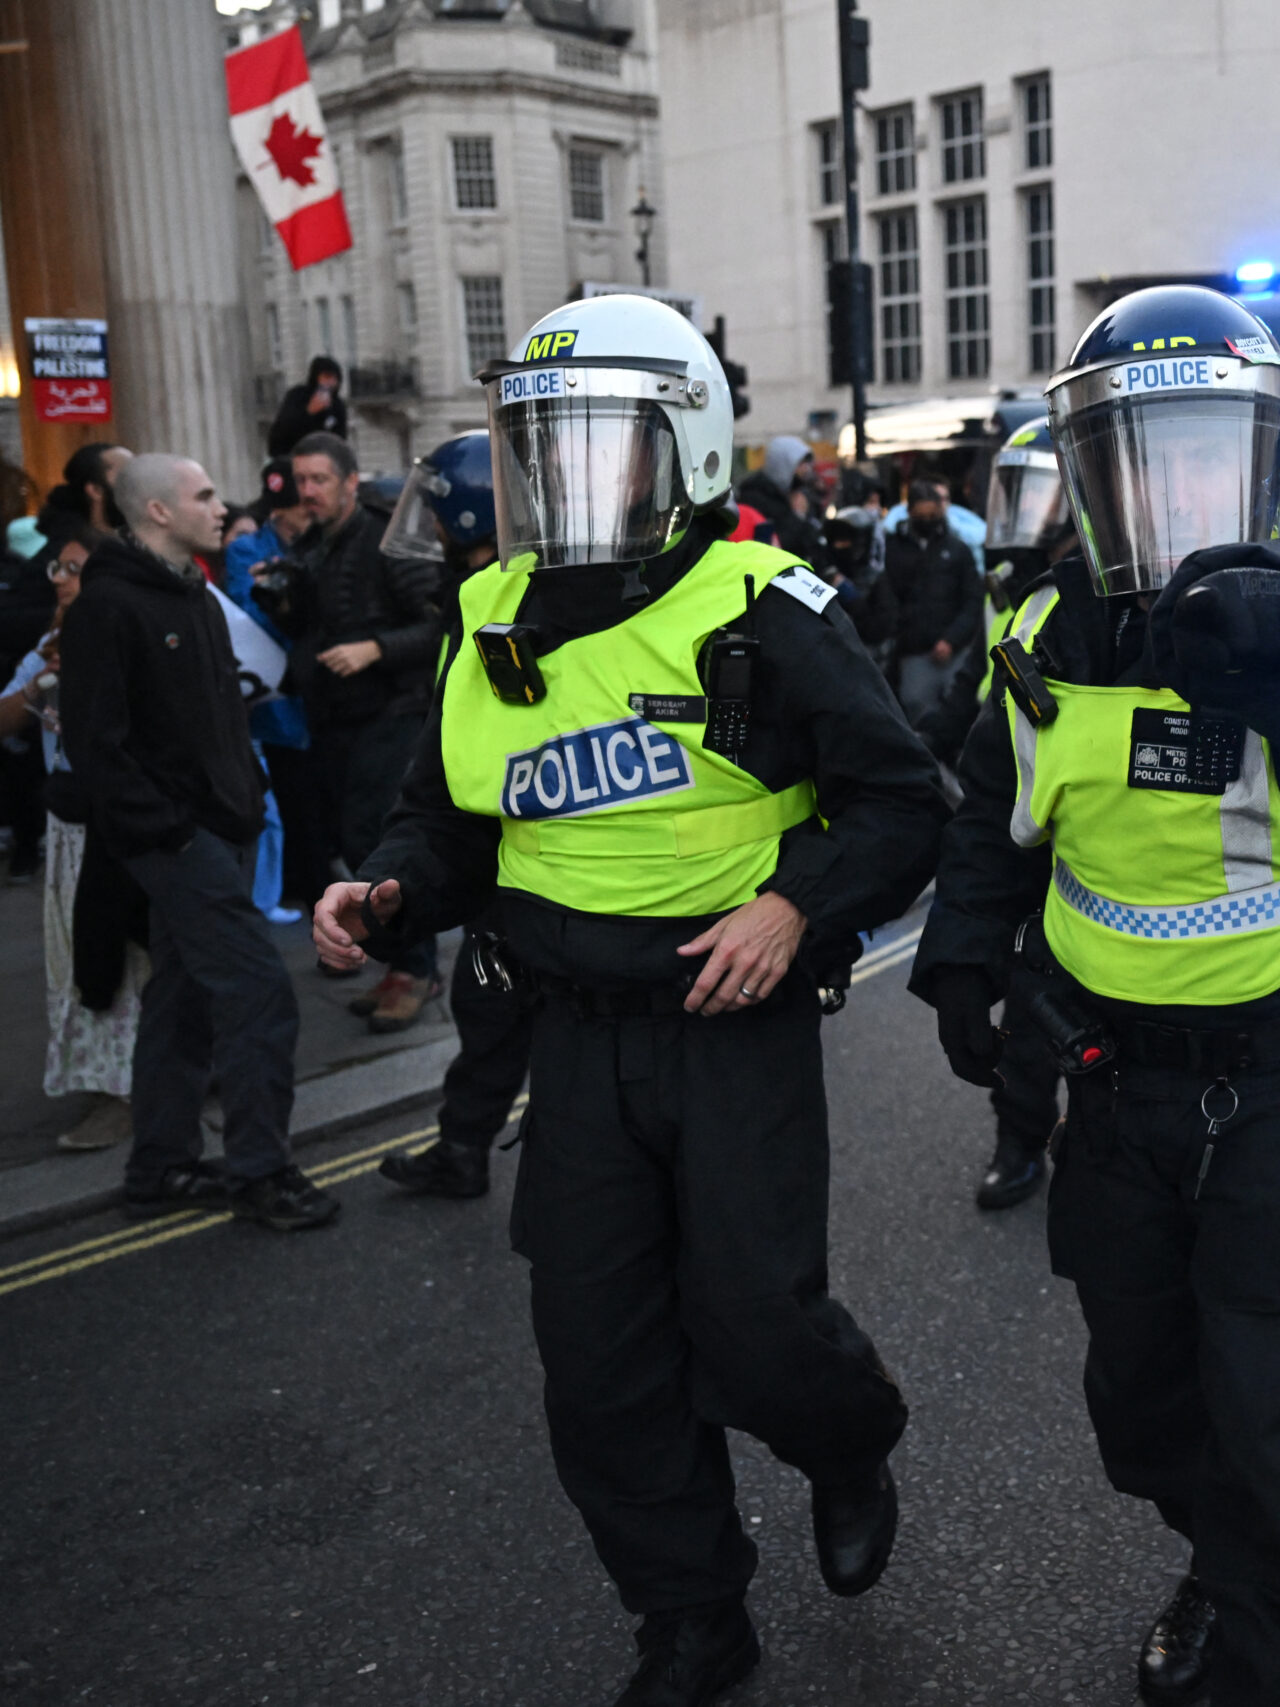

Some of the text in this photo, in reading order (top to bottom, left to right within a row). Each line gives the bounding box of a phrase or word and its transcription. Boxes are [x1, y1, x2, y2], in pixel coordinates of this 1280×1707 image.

[525, 331, 575, 361] MP
[504, 372, 560, 400] POLICE
[1127, 361, 1209, 391] POLICE
[1164, 717, 1190, 726] CONSTA
[1166, 750, 1187, 758] METR
[1172, 757, 1186, 767] PO
[509, 725, 681, 817] POLICE
[1134, 770, 1172, 782] POLICE
